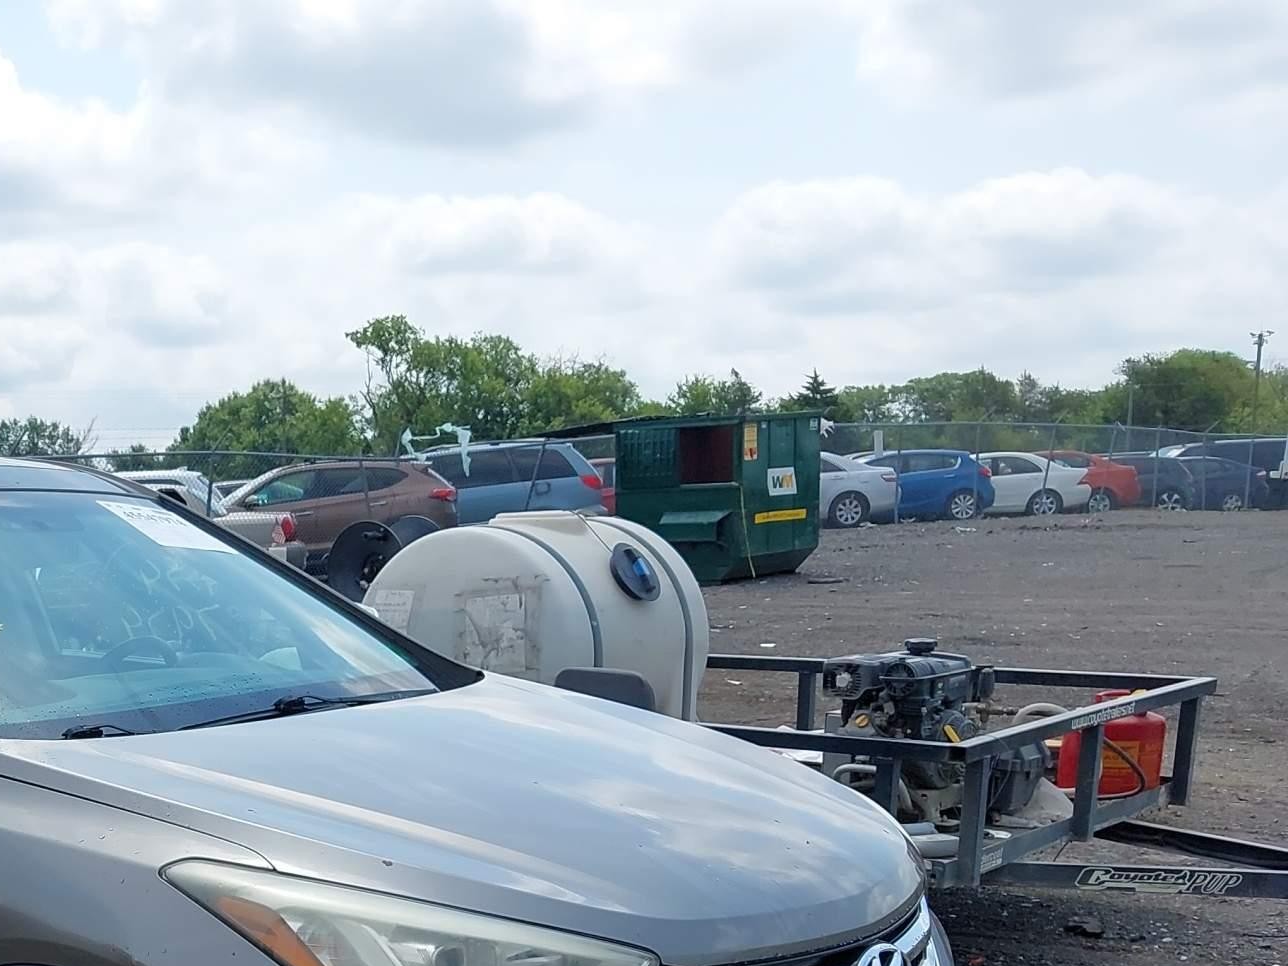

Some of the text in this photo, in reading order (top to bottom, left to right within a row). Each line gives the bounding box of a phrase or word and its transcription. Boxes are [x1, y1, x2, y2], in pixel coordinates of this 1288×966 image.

[772, 474, 793, 488] WM
[1075, 866, 1243, 894] Coyote PUP
